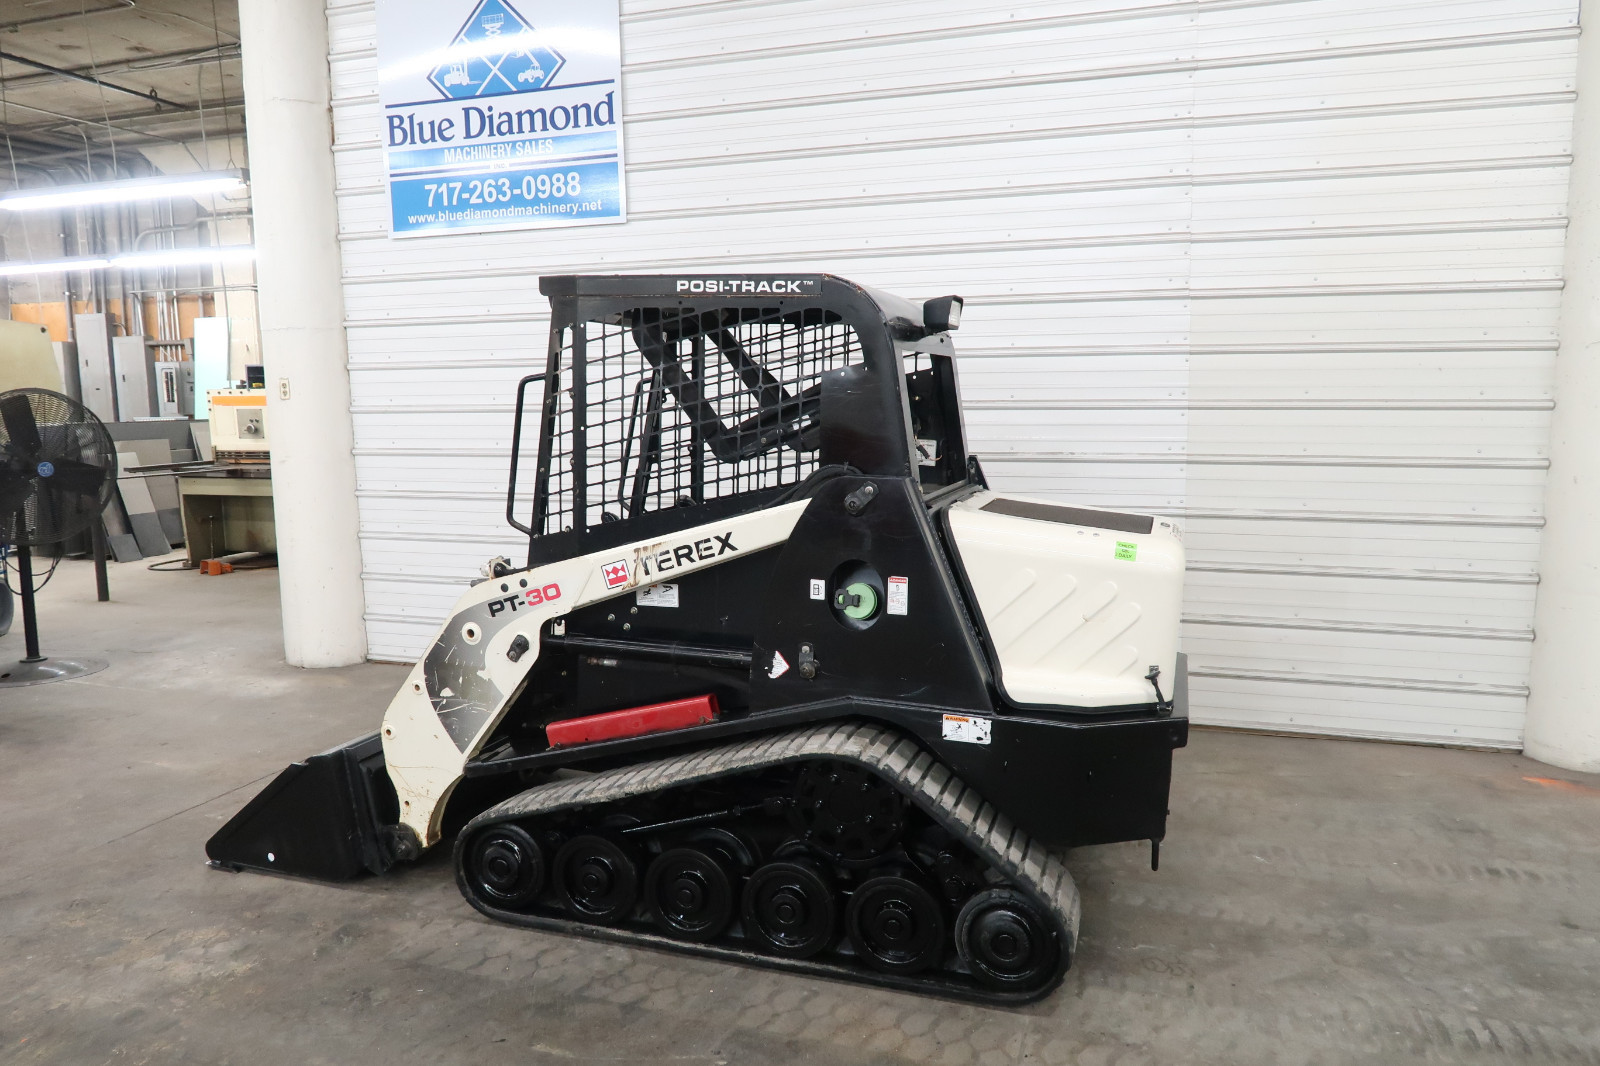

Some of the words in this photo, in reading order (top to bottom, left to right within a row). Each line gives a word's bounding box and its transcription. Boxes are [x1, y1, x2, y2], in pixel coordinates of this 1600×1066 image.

[387, 113, 455, 147] Blue
[462, 91, 615, 140] Diamond
[444, 143, 513, 163] MACHINERY
[516, 139, 553, 156] SALES
[424, 172, 581, 208] 717-263-0988
[408, 199, 602, 225] www.bluediamondmachinery.net
[634, 532, 738, 576] TEREX
[488, 582, 562, 618] PT-30
